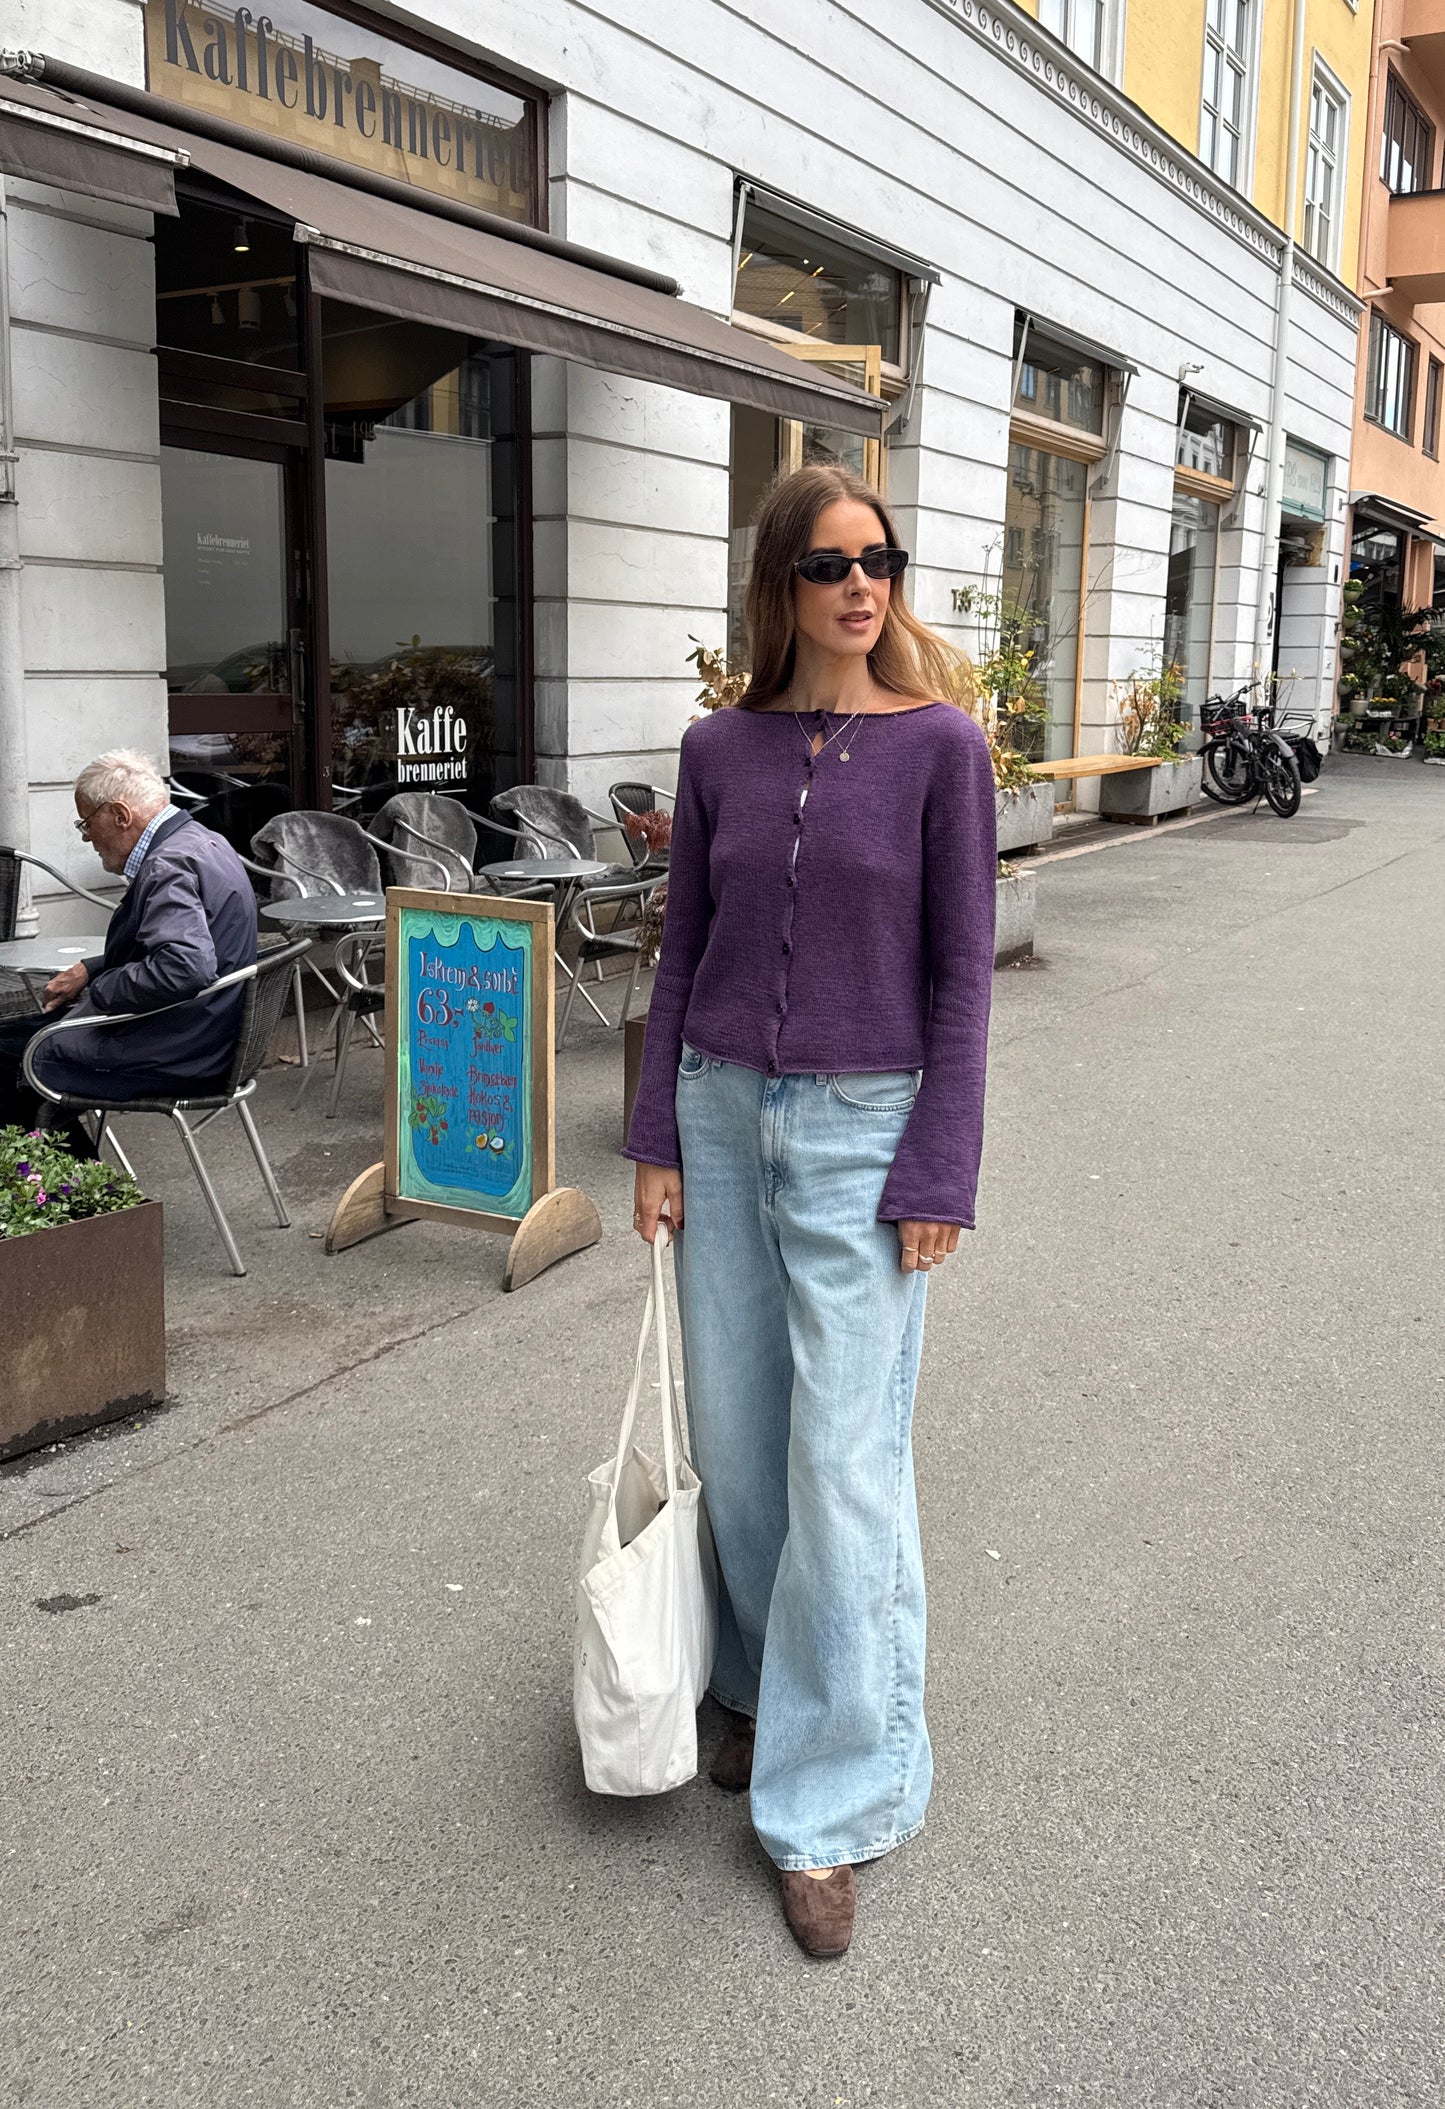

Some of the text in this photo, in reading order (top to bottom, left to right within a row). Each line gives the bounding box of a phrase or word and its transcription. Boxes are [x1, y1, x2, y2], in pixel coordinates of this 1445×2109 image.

[163, 0, 525, 194] Kaffebrenneriet
[396, 705, 467, 755] Kaffe
[397, 756, 467, 783] brenneriet
[468, 966, 482, 992] &
